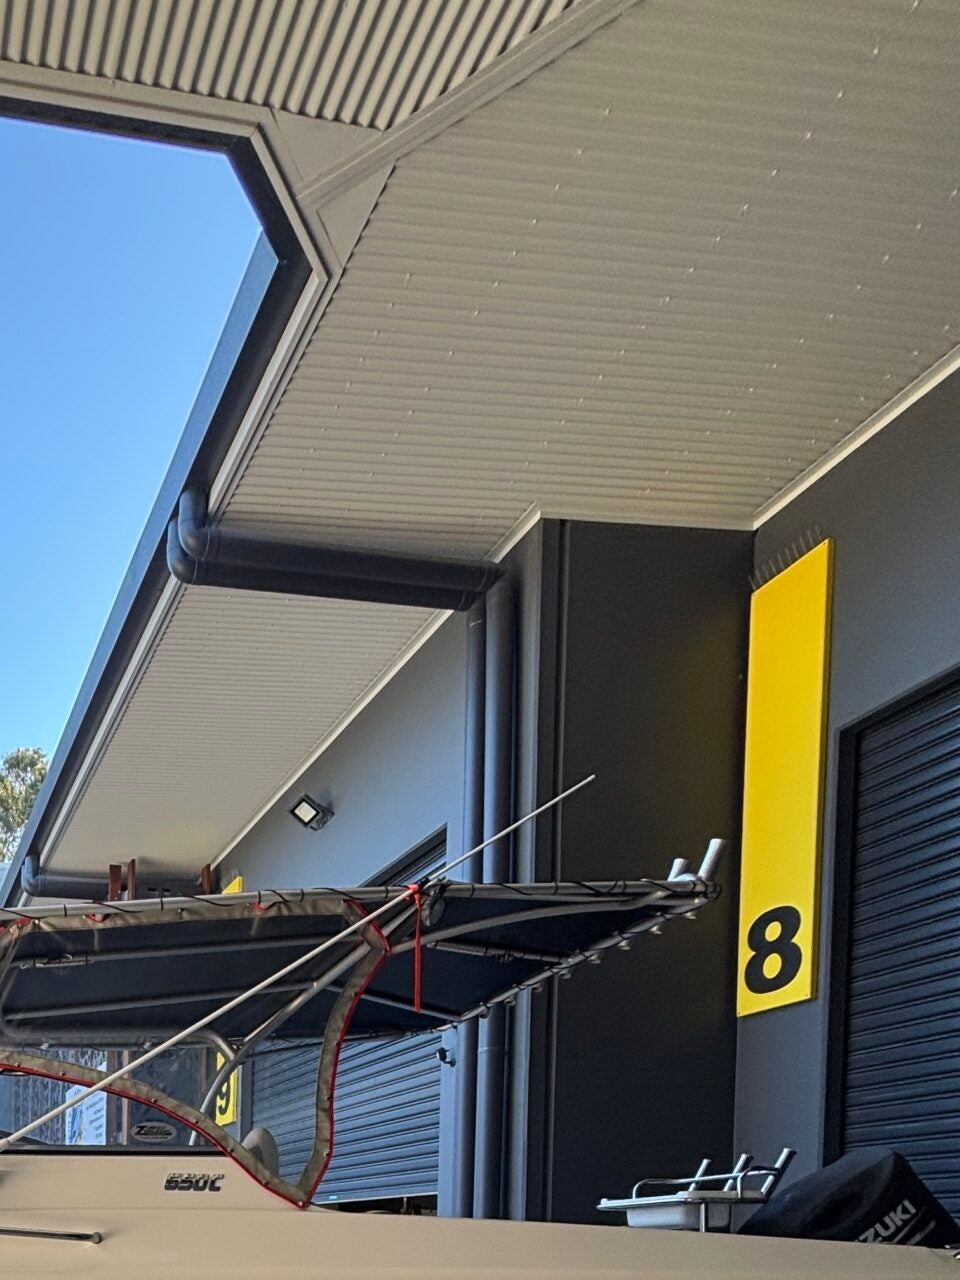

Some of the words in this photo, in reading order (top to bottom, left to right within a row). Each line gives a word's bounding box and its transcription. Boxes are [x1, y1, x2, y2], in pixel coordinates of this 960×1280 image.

[744, 905, 803, 994] 8
[164, 1173, 225, 1192] 650C
[855, 1199, 917, 1244] ZUKI
